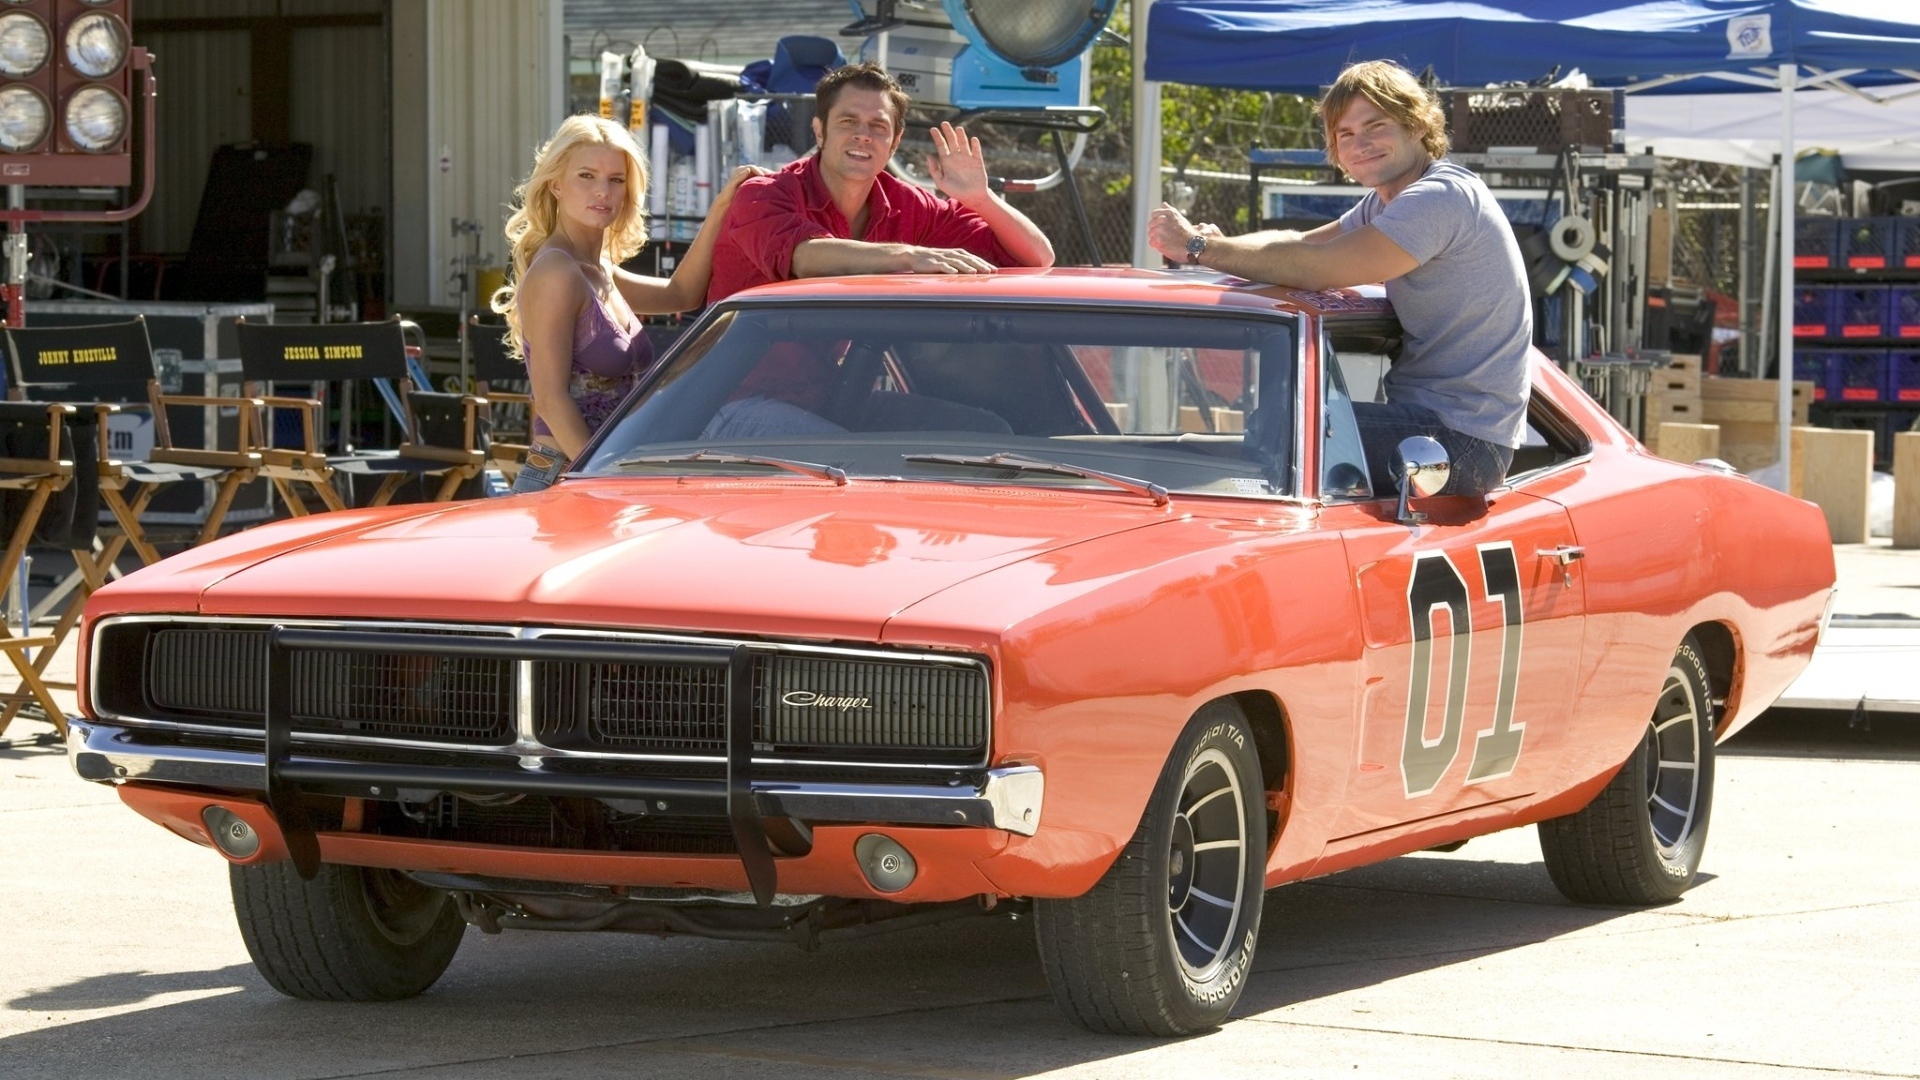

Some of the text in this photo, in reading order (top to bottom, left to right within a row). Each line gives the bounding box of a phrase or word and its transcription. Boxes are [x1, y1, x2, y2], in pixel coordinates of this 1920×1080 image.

[39, 347, 117, 365] JOHNNY KNOXVILLE
[284, 345, 362, 360] JESSICA SIMPSON
[1400, 540, 1526, 799] 01
[1676, 644, 1713, 731] FGoodrich
[782, 691, 873, 712] Charger
[1184, 723, 1244, 780] Radial T/A
